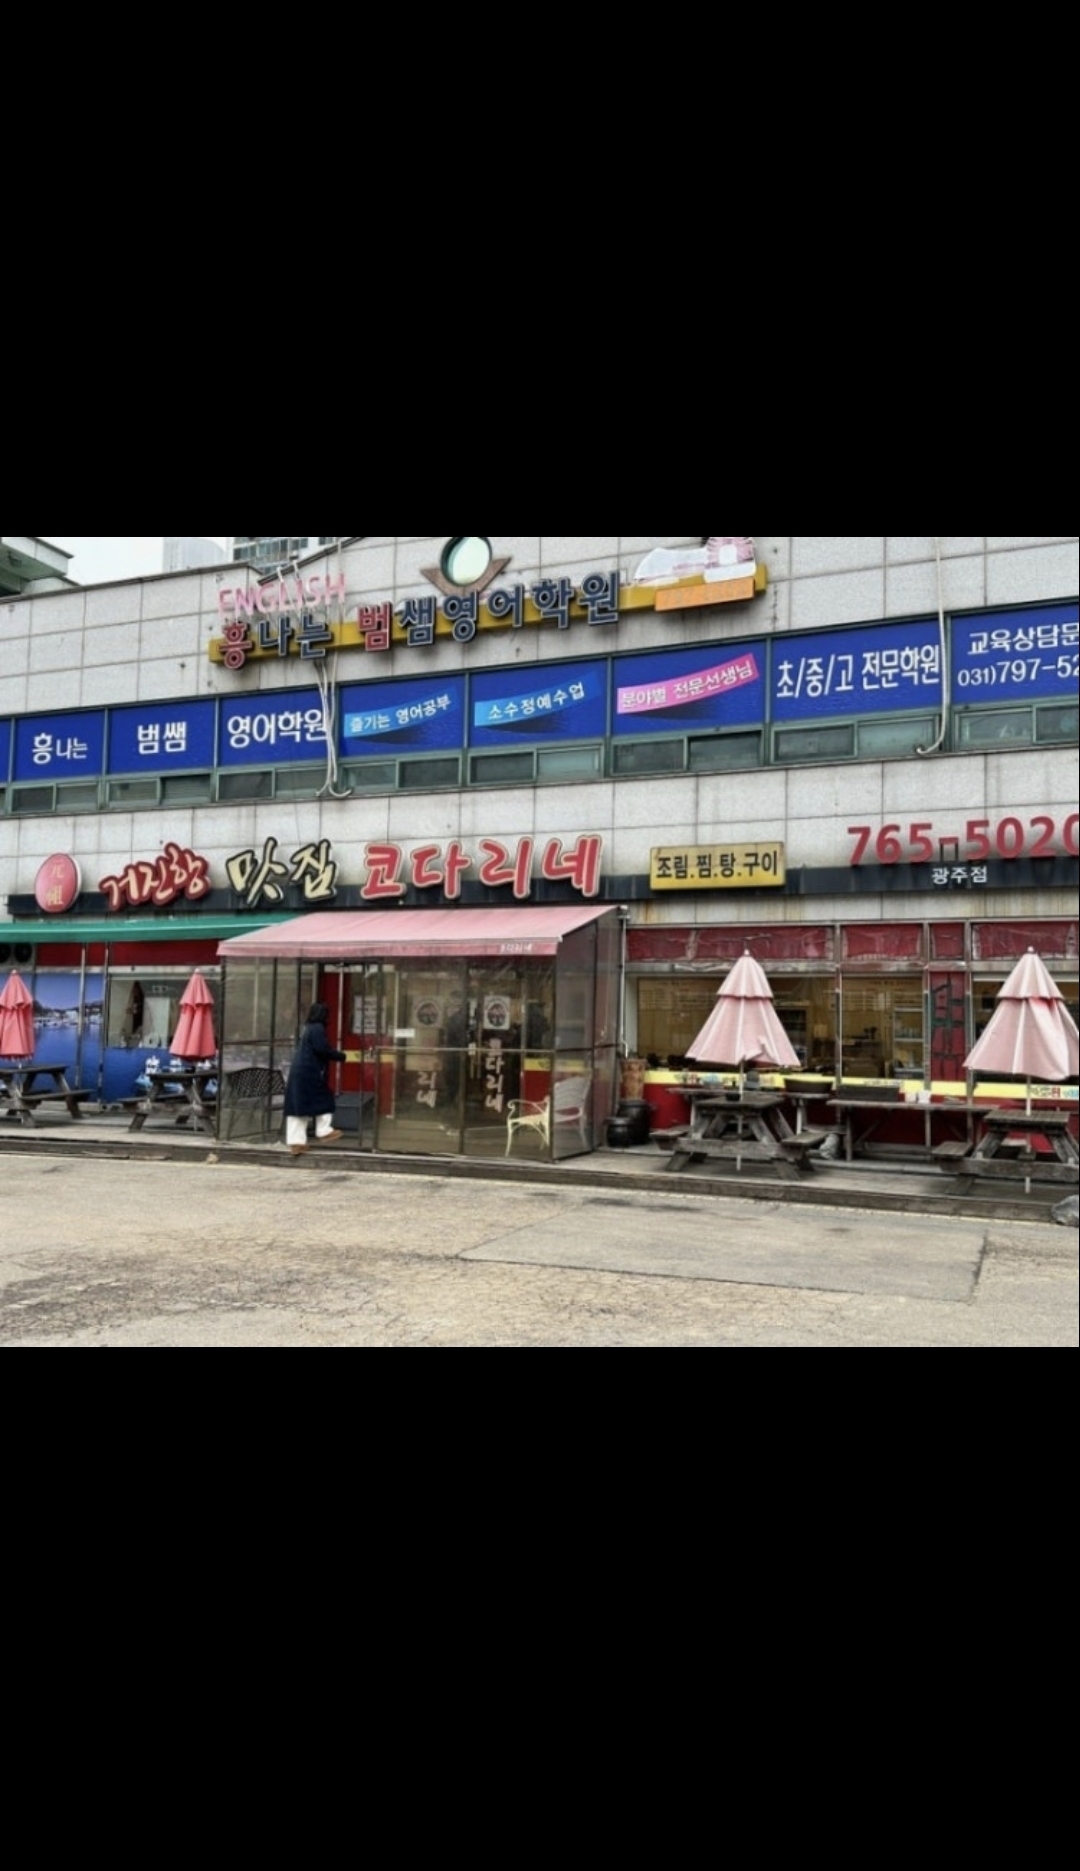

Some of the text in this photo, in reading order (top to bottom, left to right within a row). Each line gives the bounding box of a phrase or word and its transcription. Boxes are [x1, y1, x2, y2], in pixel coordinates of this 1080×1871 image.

[218, 572, 346, 619] ENGLISH
[219, 614, 332, 669] 흥나는
[673, 660, 753, 698] 전문선생님
[777, 645, 939, 698] 초/중/고 전문학원
[350, 694, 451, 733] 즐기는 영어공부
[488, 682, 585, 720] 소수정예수업
[137, 721, 187, 755] 범쌤
[227, 709, 327, 749] 영어학원
[32, 733, 88, 764] 흥나는
[100, 835, 601, 909] 거진항 맛집 코다리네
[656, 850, 778, 879] 조림.찜.탕.구이
[931, 865, 988, 884] 광주점
